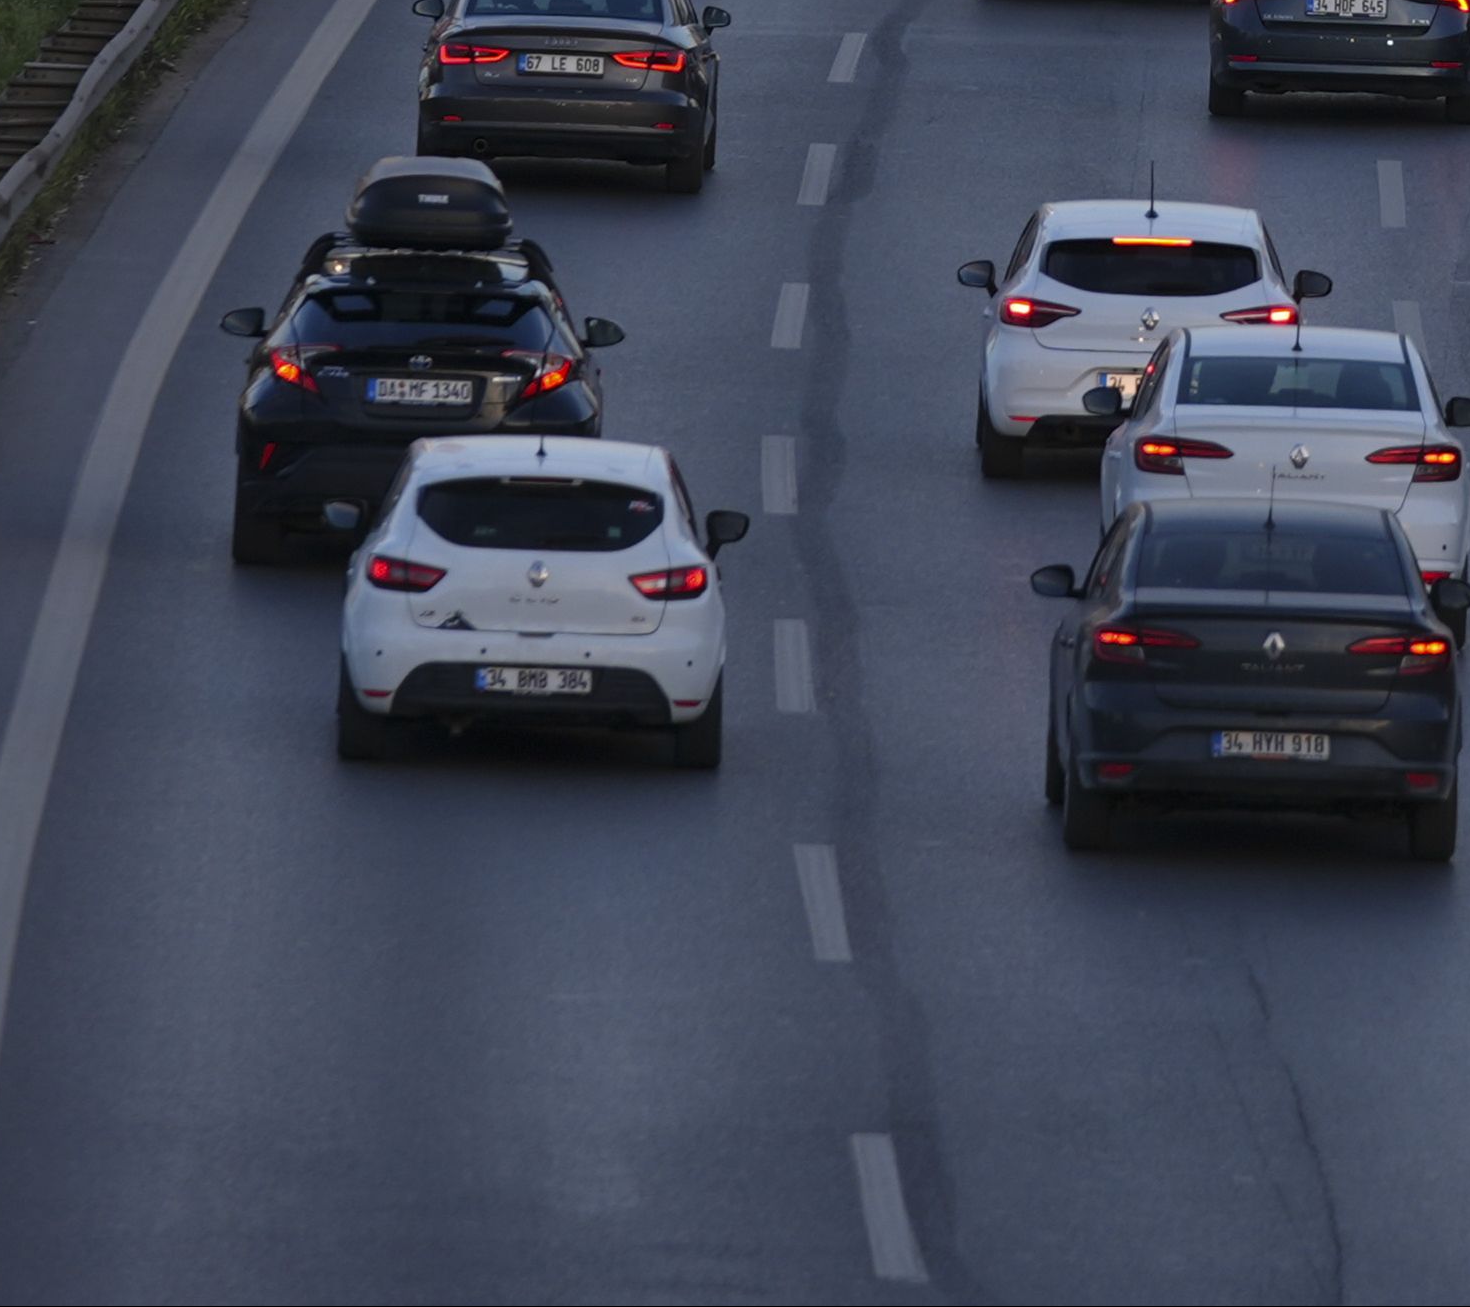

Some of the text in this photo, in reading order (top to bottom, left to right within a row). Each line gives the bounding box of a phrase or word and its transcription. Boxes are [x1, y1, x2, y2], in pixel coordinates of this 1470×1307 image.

[1362, 0, 1385, 13] 645
[526, 56, 600, 72] 67 LE 608
[432, 381, 470, 400] 1340
[487, 669, 506, 687] 34
[559, 672, 588, 690] 384
[1223, 733, 1324, 754] 34 HYH 918
